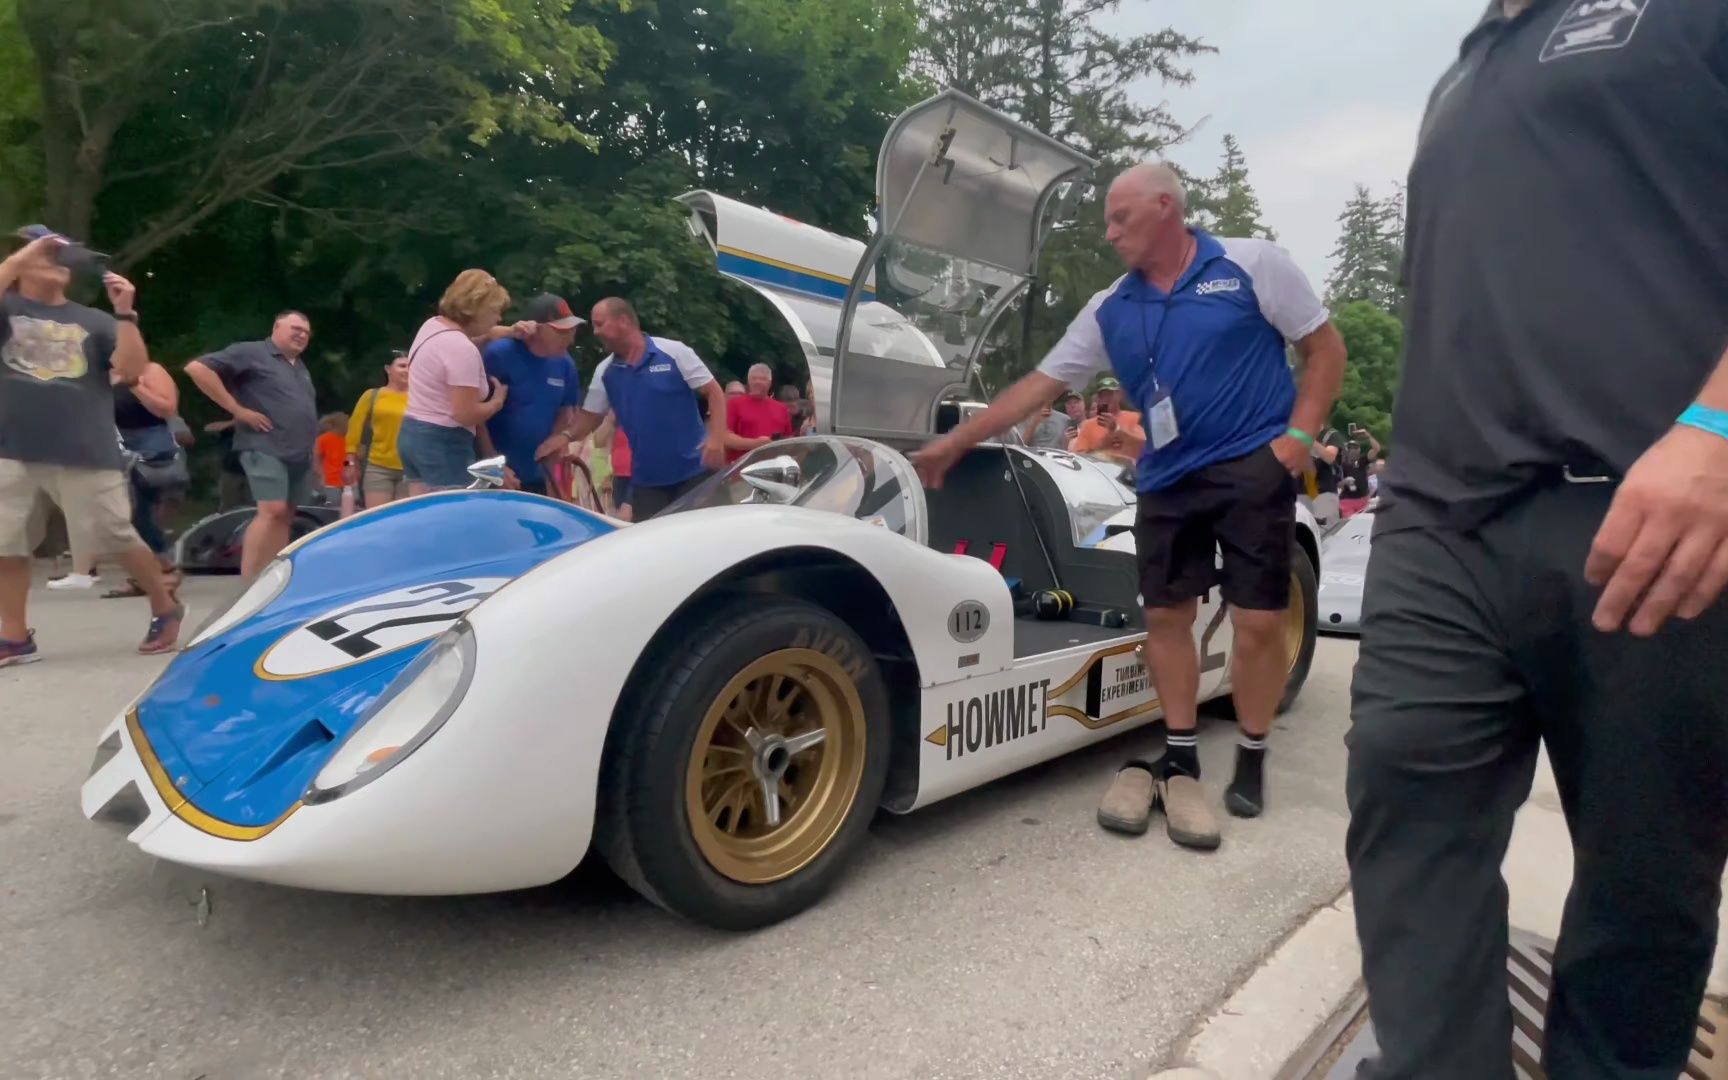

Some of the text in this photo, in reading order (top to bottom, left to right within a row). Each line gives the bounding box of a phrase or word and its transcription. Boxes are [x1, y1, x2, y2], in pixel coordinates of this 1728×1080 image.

[955, 608, 983, 633] 112
[788, 625, 872, 682] AVON
[946, 678, 1051, 761] HOWMET
